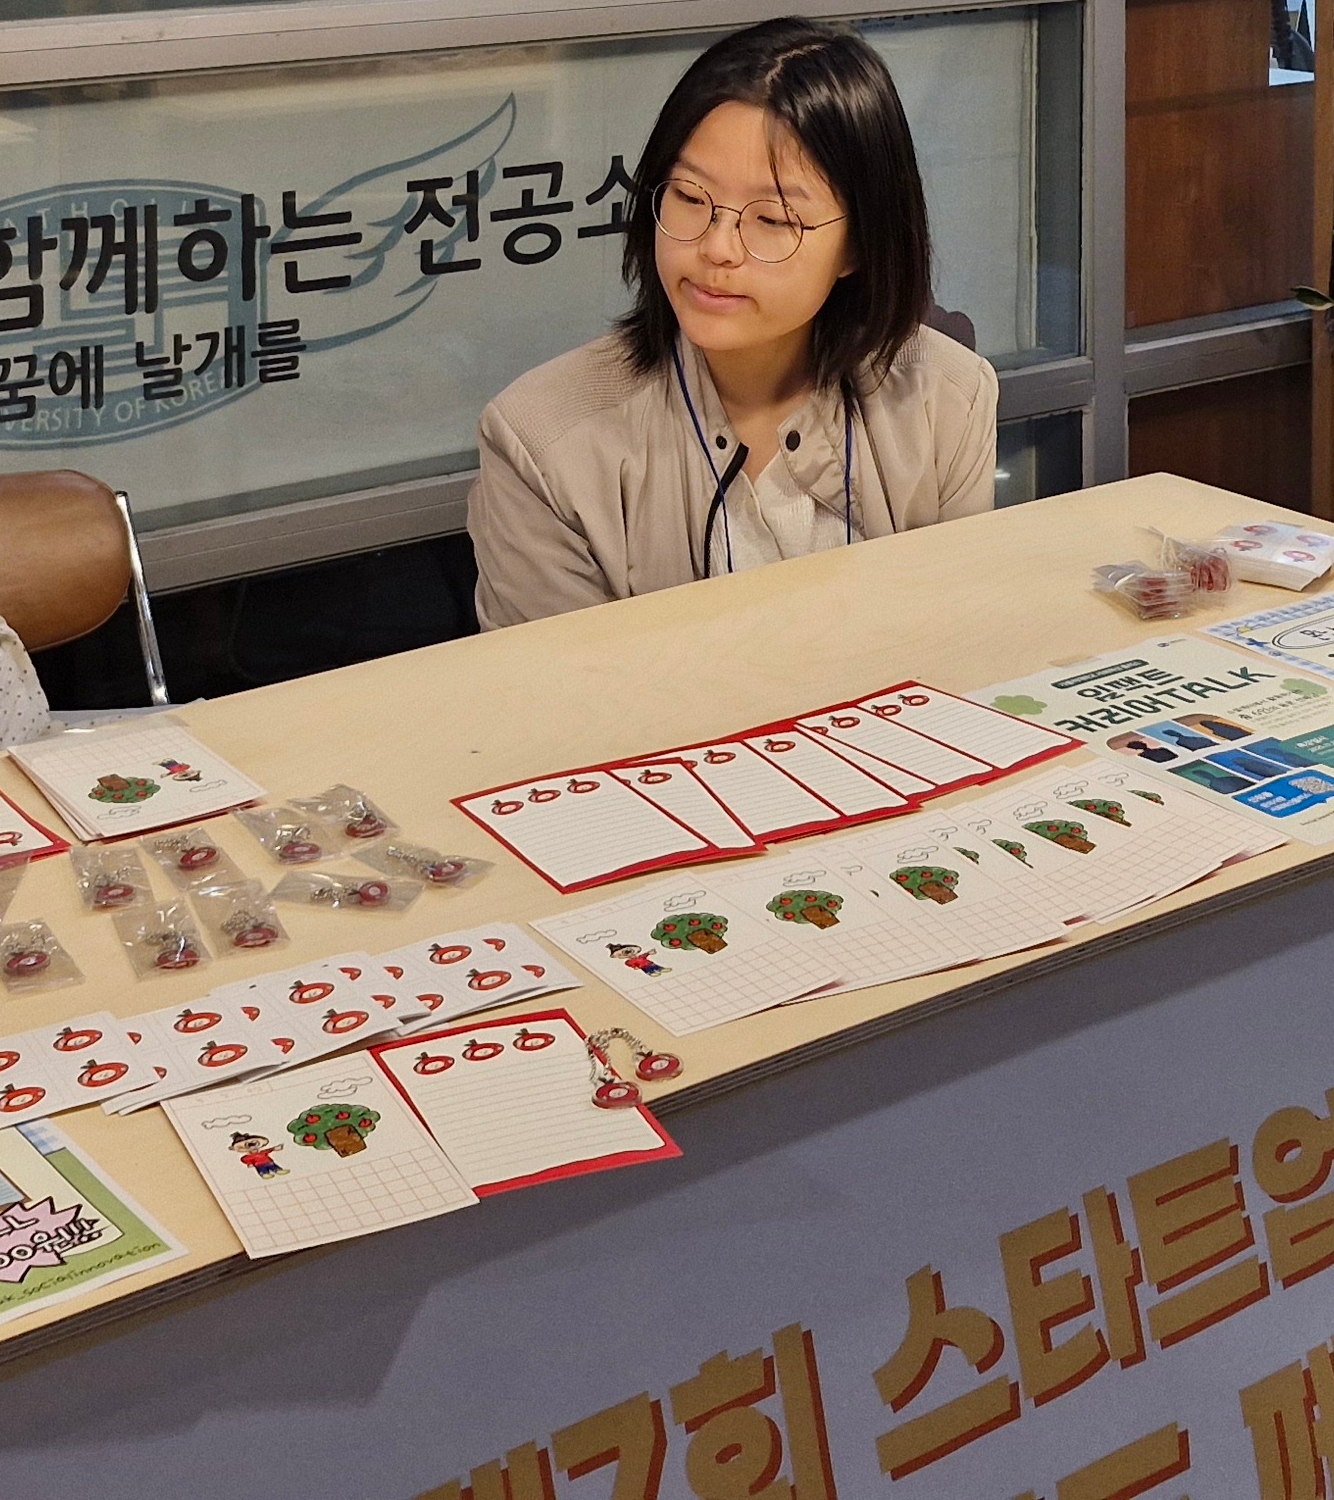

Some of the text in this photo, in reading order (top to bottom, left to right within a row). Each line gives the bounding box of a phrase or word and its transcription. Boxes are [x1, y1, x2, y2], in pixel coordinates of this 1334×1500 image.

[136, 318, 307, 400] 날개를
[116, 399, 146, 423] OF
[405, 1320, 839, 1500] 7회
